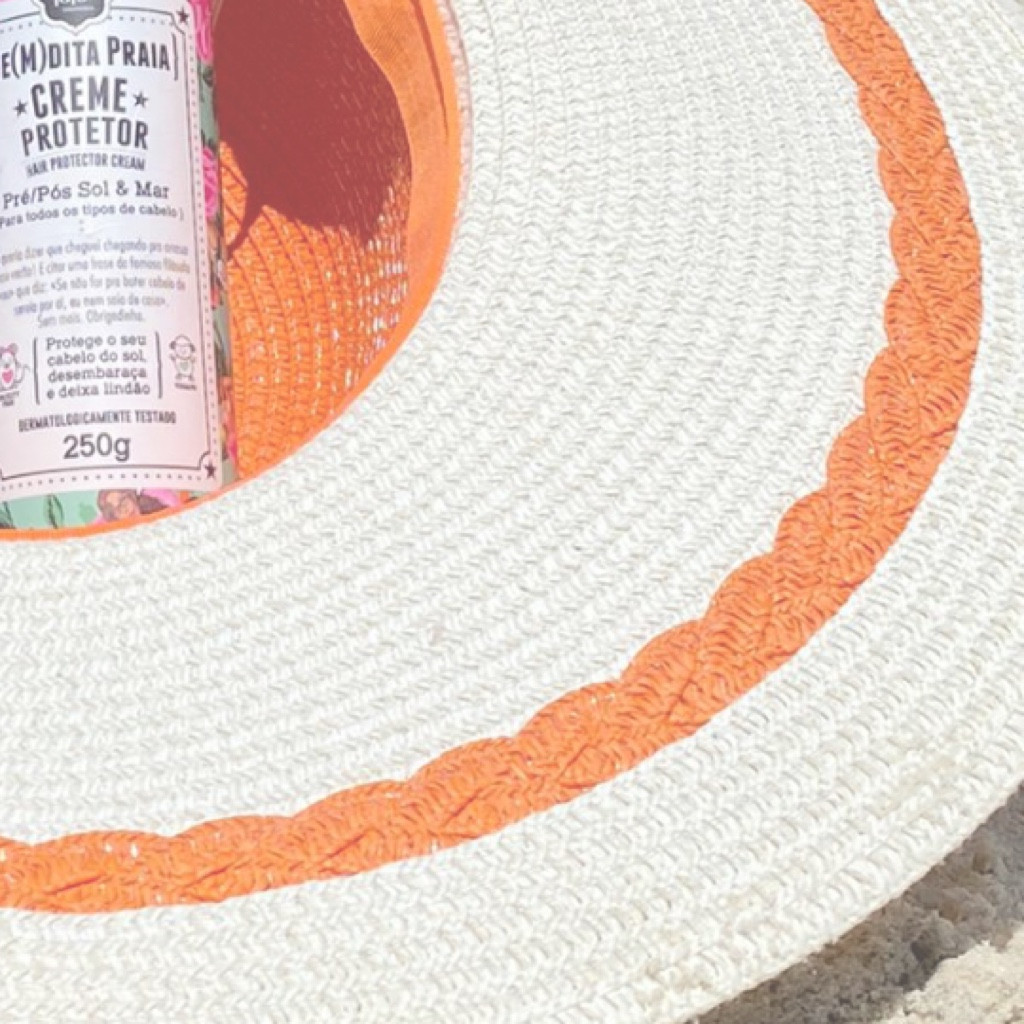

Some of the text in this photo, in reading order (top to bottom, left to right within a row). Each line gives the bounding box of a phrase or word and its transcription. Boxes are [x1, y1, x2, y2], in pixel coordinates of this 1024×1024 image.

[31, 75, 129, 119] CREME
[20, 116, 150, 157] PROTETOR
[26, 153, 146, 177] HAIR PROTECTOR CREAM
[3, 180, 170, 210] Pré/Pós Sol & Mar
[26, 208, 60, 222] todos
[62, 206, 79, 217] os
[82, 203, 115, 217] tipos
[119, 203, 136, 215] de
[46, 335, 147, 351] Protege o seu
[47, 350, 96, 367] cabelo
[99, 349, 118, 363] do
[48, 366, 147, 382] desembaraça
[46, 381, 151, 400] e deixa lindão
[19, 409, 177, 433] DERMATOLOGICAMENTE TESTADO
[62, 432, 132, 462] 250g
